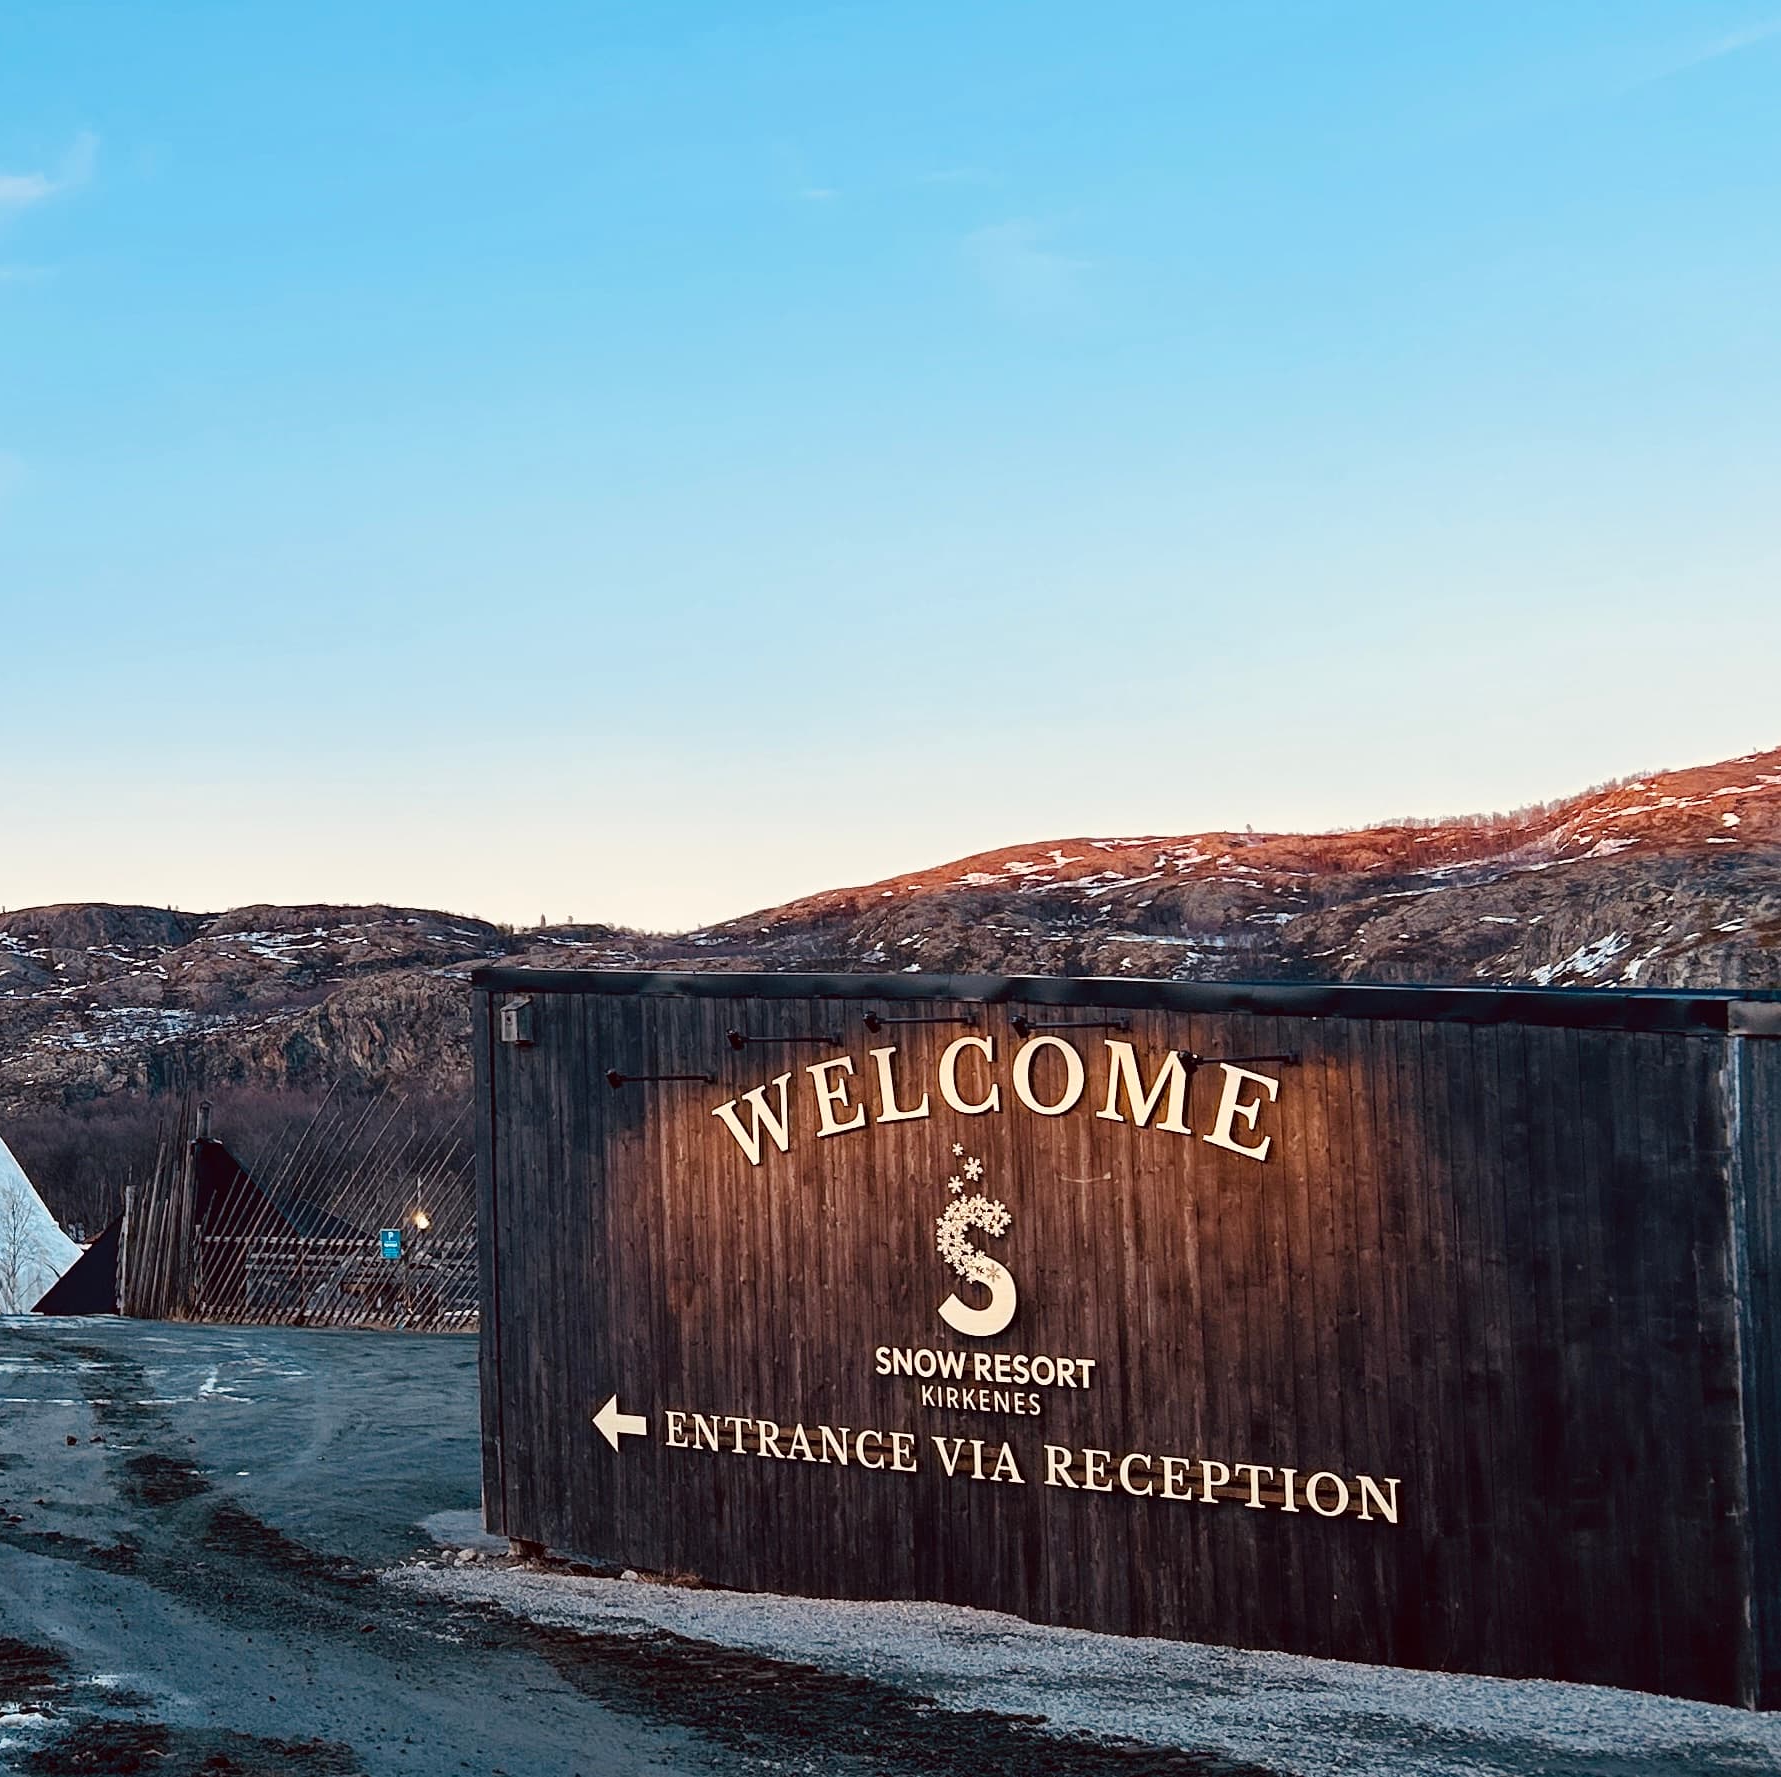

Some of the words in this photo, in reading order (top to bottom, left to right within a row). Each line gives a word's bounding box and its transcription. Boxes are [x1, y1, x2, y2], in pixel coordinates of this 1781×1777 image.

[712, 1037, 1279, 1165] WELCOME
[875, 1346, 967, 1380] SNOW
[973, 1352, 1096, 1389] RESORT
[921, 1384, 1041, 1416] KIRKENES
[665, 1410, 917, 1473] ENTRANCE
[931, 1436, 1025, 1484] VIA
[1043, 1444, 1401, 1524] RECEPTION
